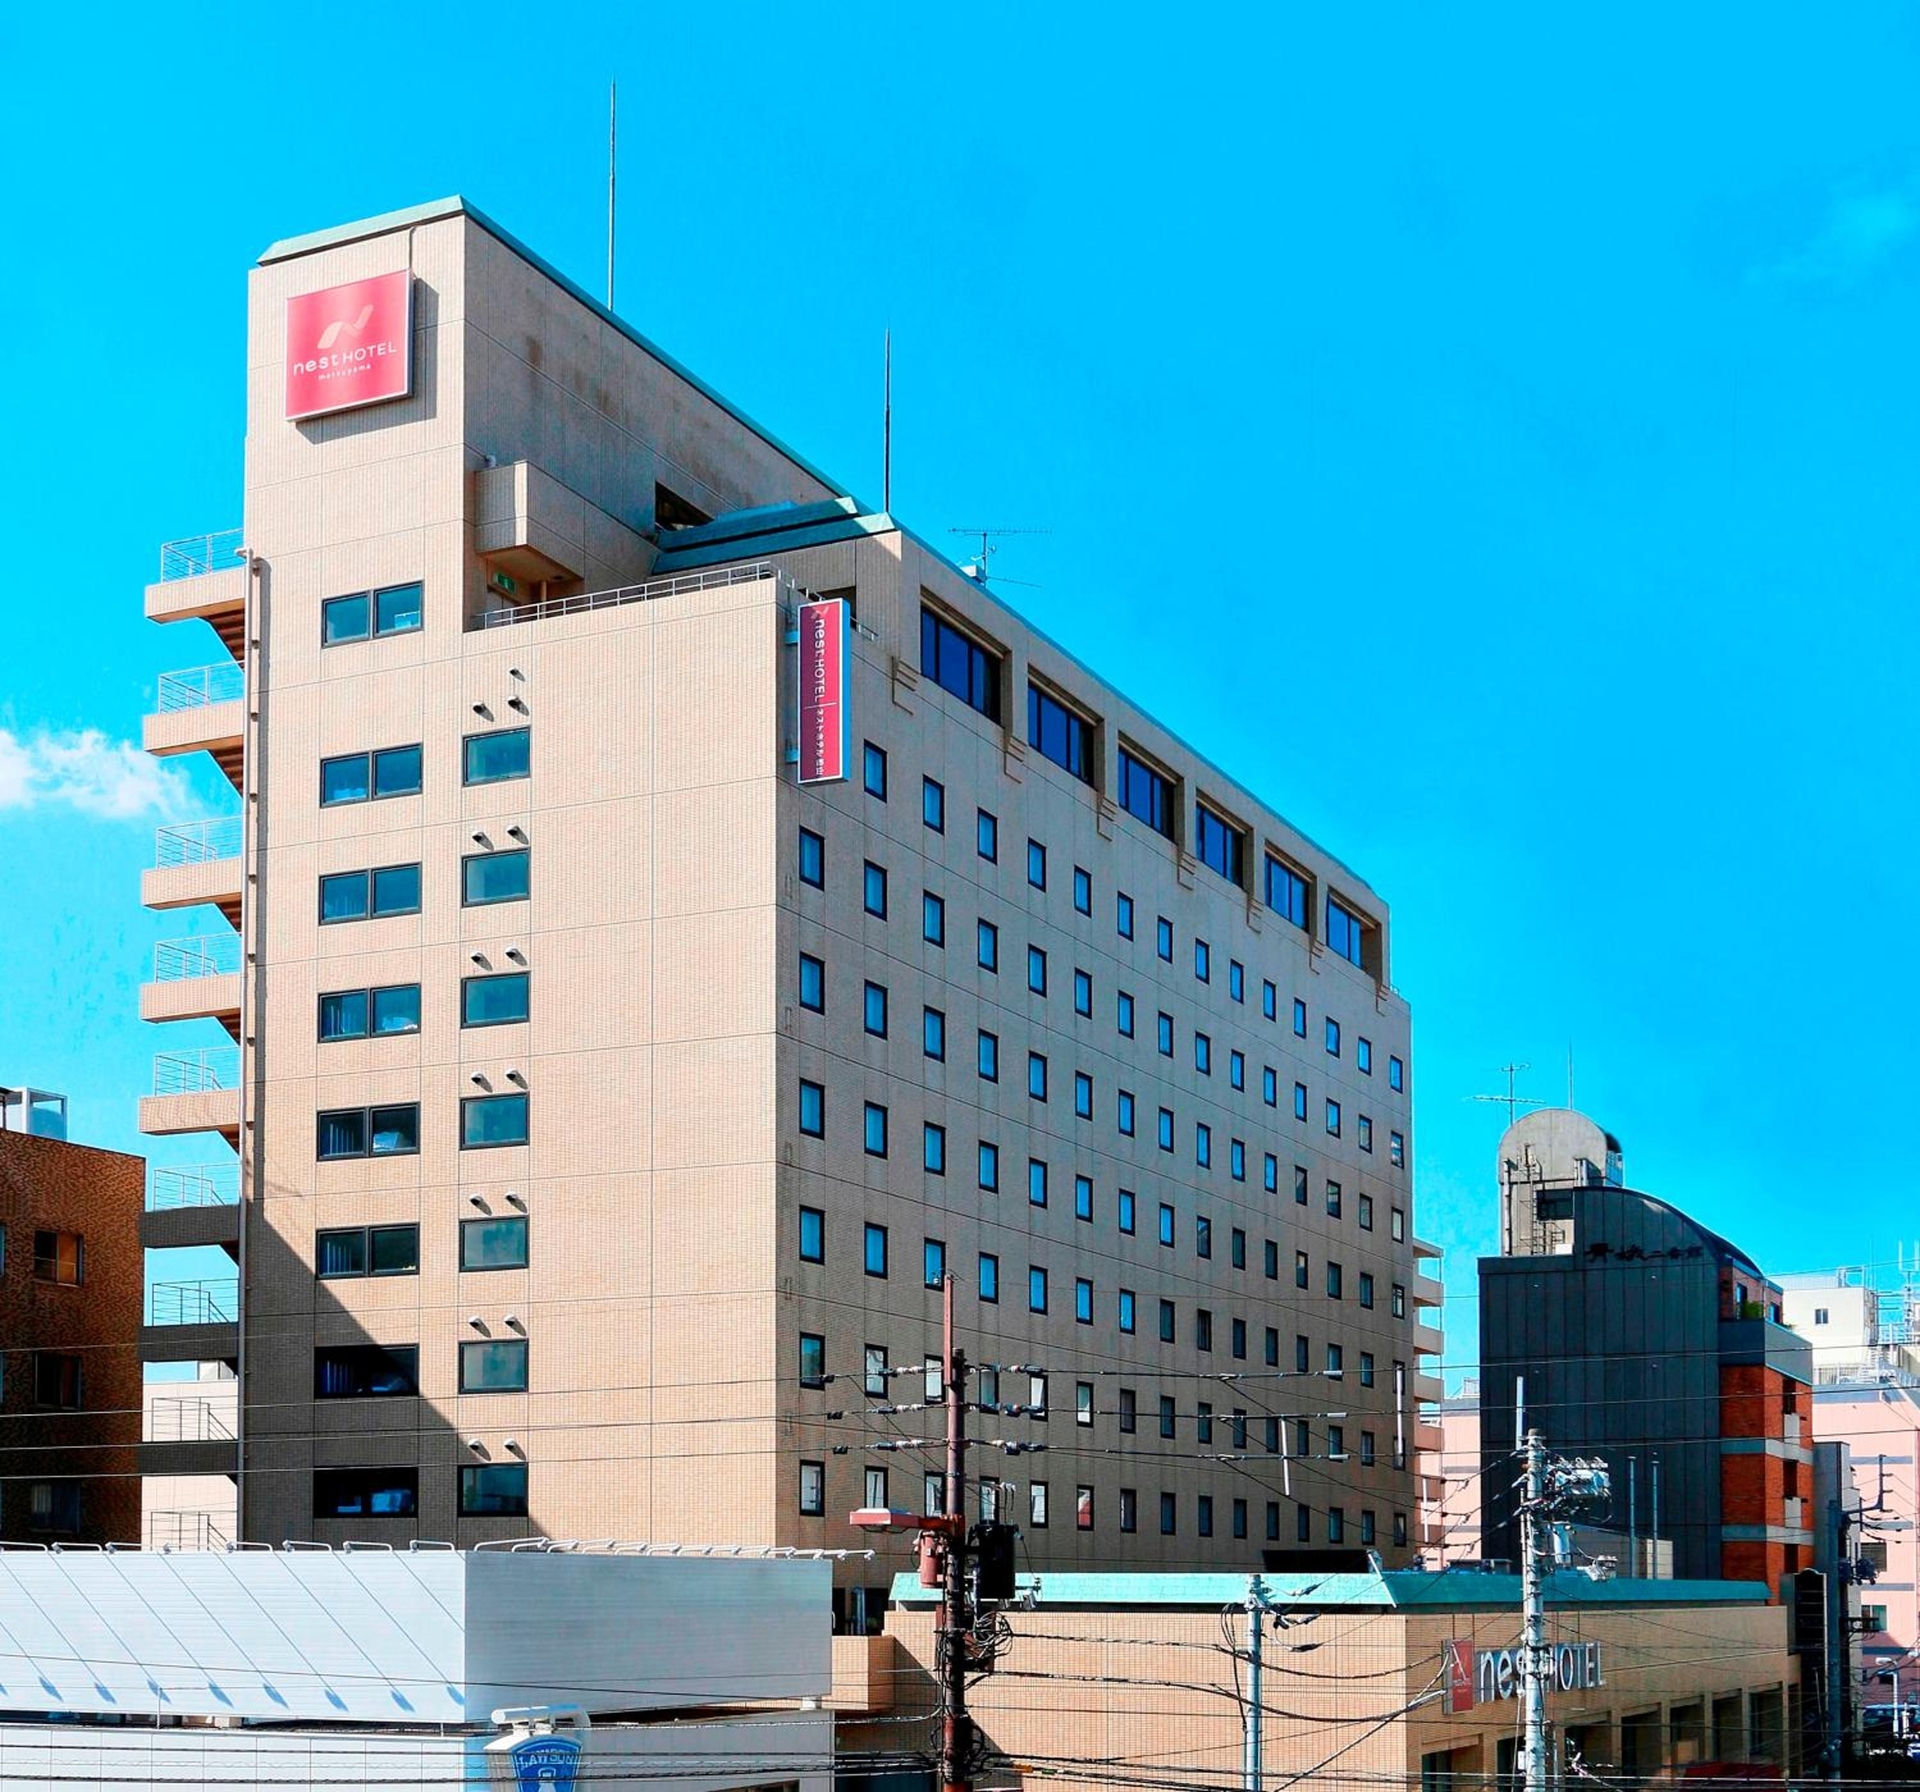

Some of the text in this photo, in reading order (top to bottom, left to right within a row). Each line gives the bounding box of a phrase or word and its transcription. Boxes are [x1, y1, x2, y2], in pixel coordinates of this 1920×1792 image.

[293, 340, 397, 376] nest HOTEL
[814, 618, 825, 703] nest HOTEL
